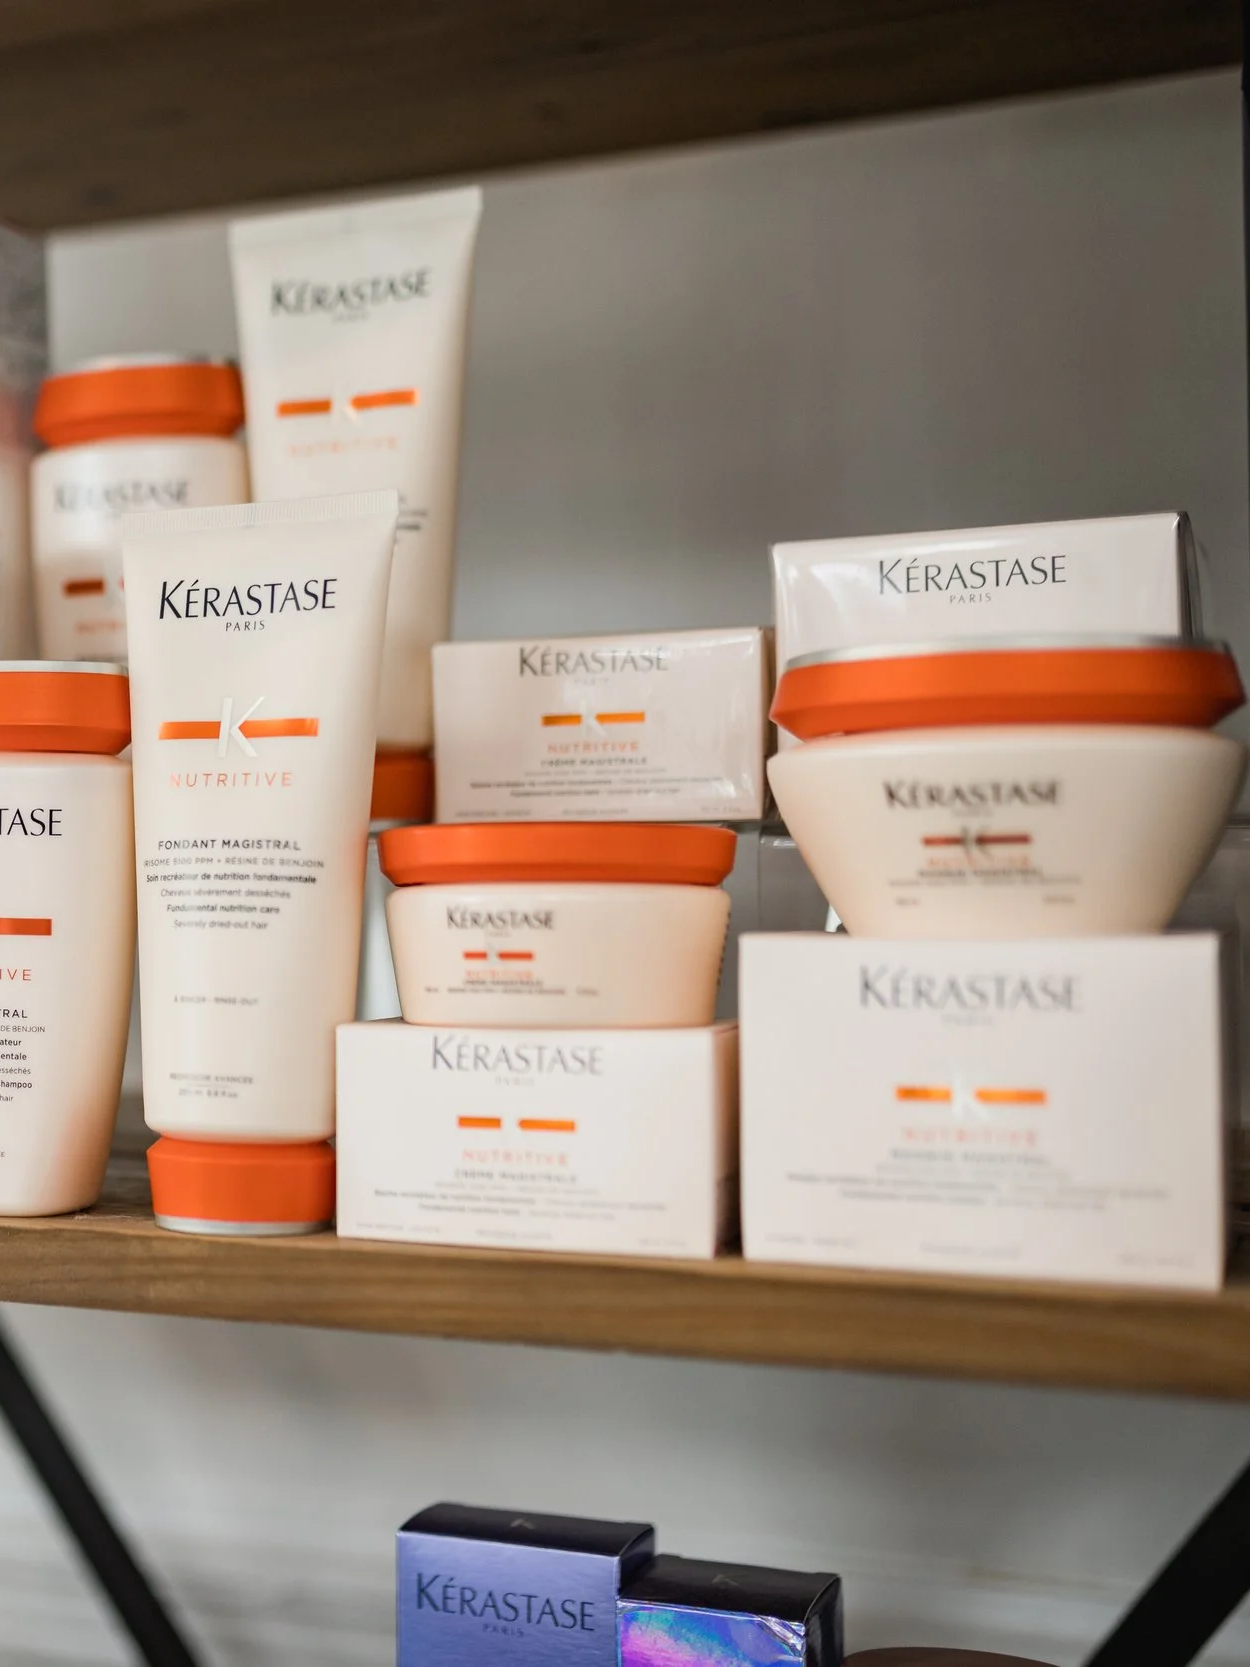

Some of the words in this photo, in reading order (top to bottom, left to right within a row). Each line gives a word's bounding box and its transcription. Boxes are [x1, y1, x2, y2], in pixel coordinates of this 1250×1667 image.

[877, 555, 1068, 595] KÉRASTASE
[159, 578, 338, 620] KÉRASTASE
[949, 592, 992, 605] PARIS
[225, 620, 266, 632] PARIS
[519, 645, 670, 677] KÉRASTASE
[216, 695, 266, 759] K
[170, 772, 295, 788] NUTRITIVE
[158, 839, 217, 850] FONDANT
[222, 839, 302, 851] MAGISTRAL
[146, 873, 159, 883] Soin
[160, 872, 199, 882] recréatr
[201, 873, 211, 881] de
[214, 872, 251, 881] nutrition
[167, 903, 218, 912] Fundental
[219, 904, 257, 913] nutrition
[174, 919, 207, 929] Sevely
[858, 964, 1083, 1013] KÉRASTASE
[12, 1025, 46, 1033] BENJOIN
[432, 1034, 605, 1076] KÉRASTASE
[0, 1094, 14, 1102] hair
[415, 1571, 597, 1633] KÉRASTASE
